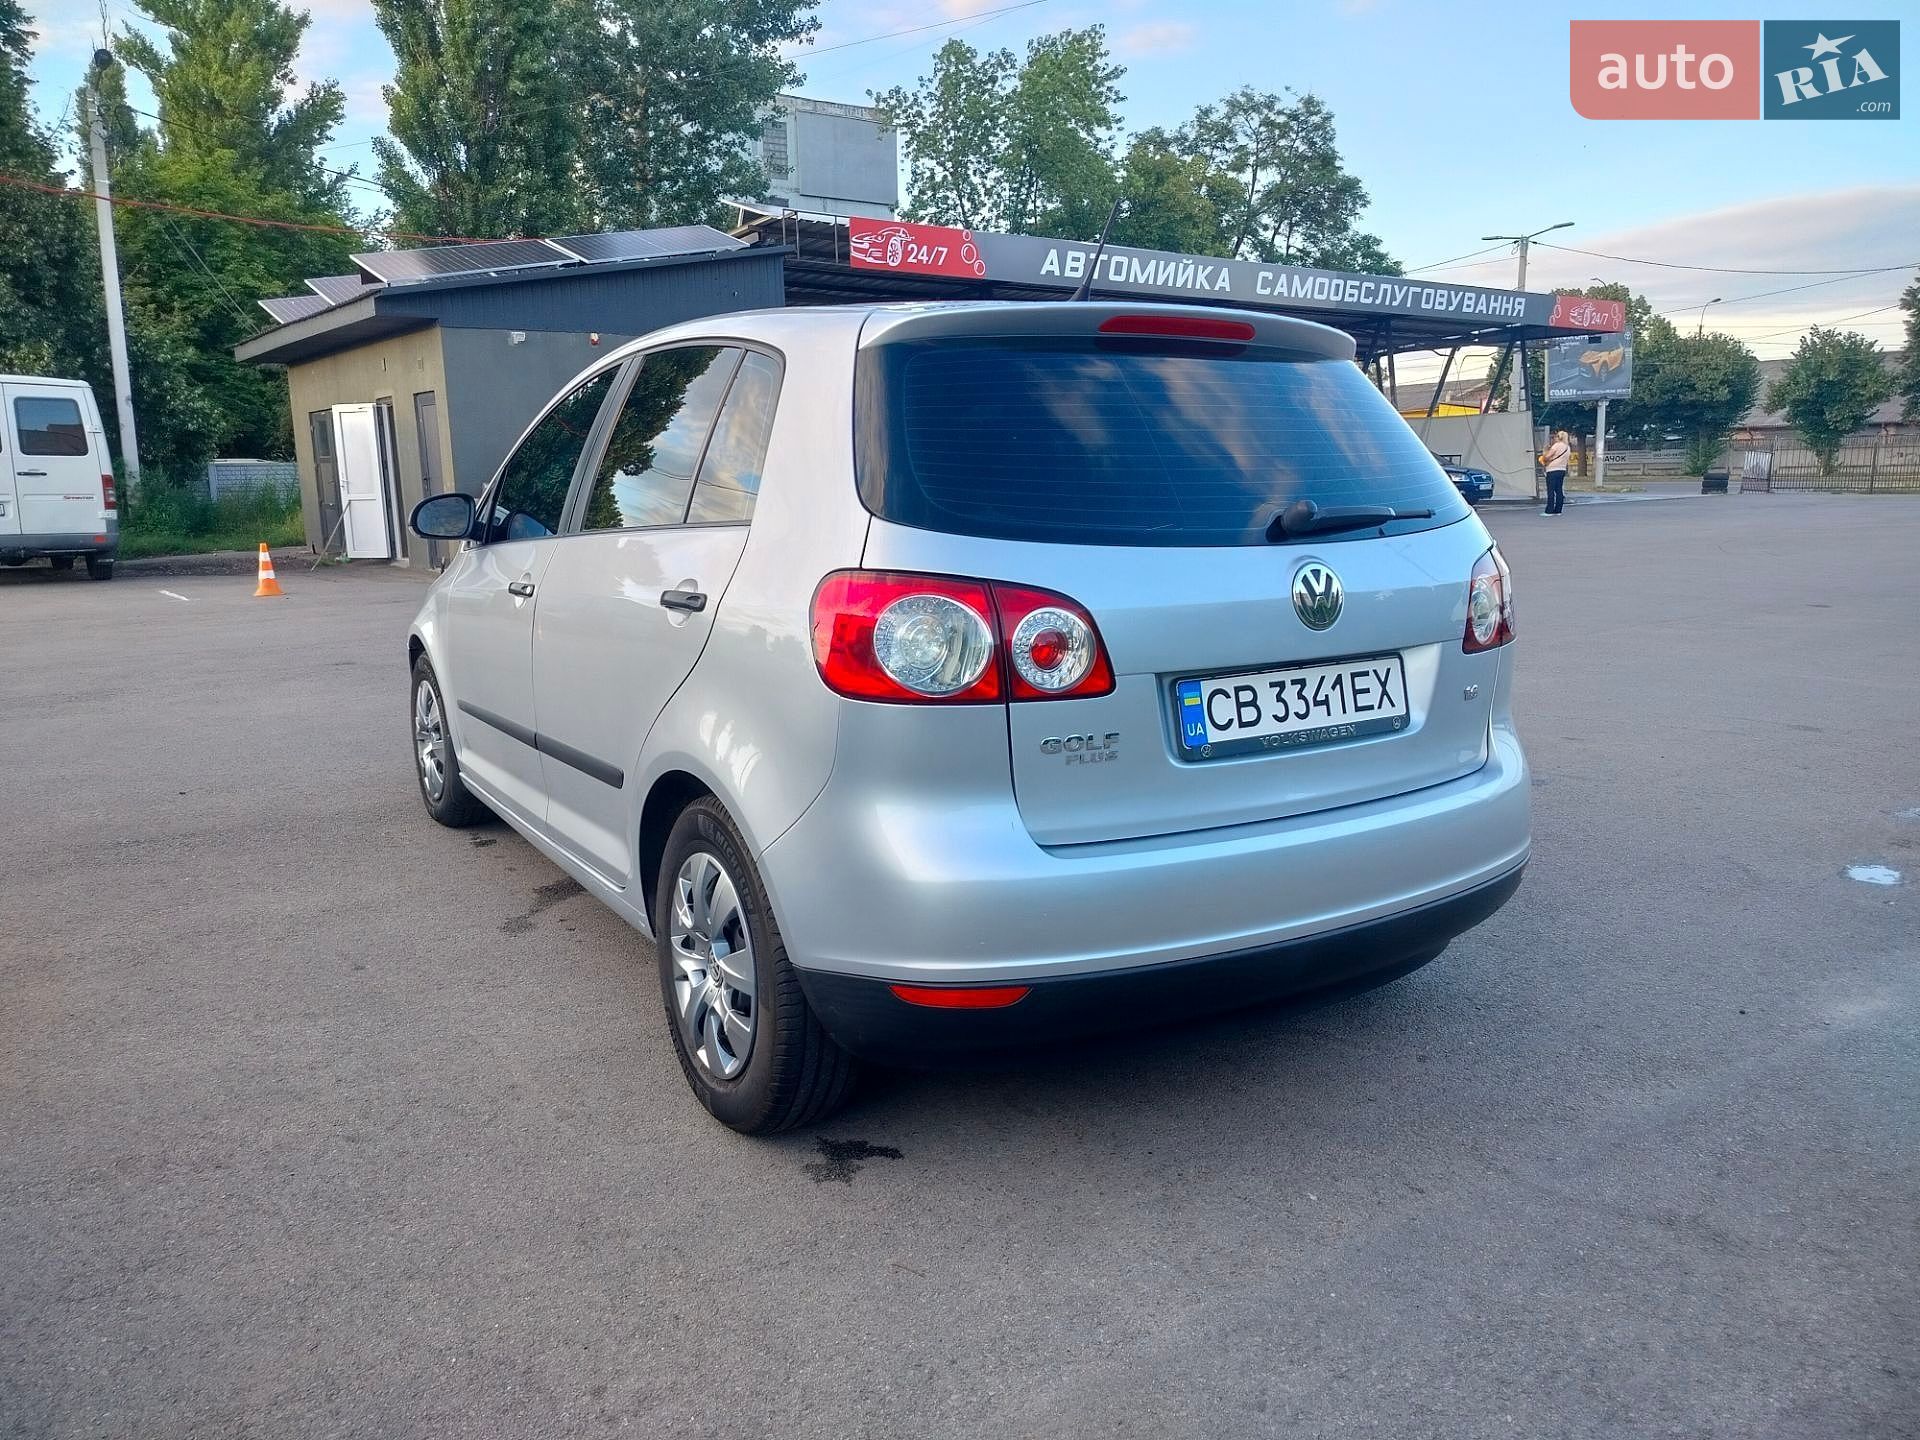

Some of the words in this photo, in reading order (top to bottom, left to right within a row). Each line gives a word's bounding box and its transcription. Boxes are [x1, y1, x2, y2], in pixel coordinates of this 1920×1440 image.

[906, 243, 949, 267] 24/7
[1040, 247, 1231, 293] АВТОМИЙКА
[1256, 271, 1526, 318] САМООБСЛУГОВУВАННЯ
[1591, 312, 1609, 325] 24/7
[1187, 721, 1205, 737] UA
[1259, 723, 1357, 749] VOLKSWAGEN
[1040, 732, 1120, 755] GOLF
[1065, 750, 1119, 766] PLUS
